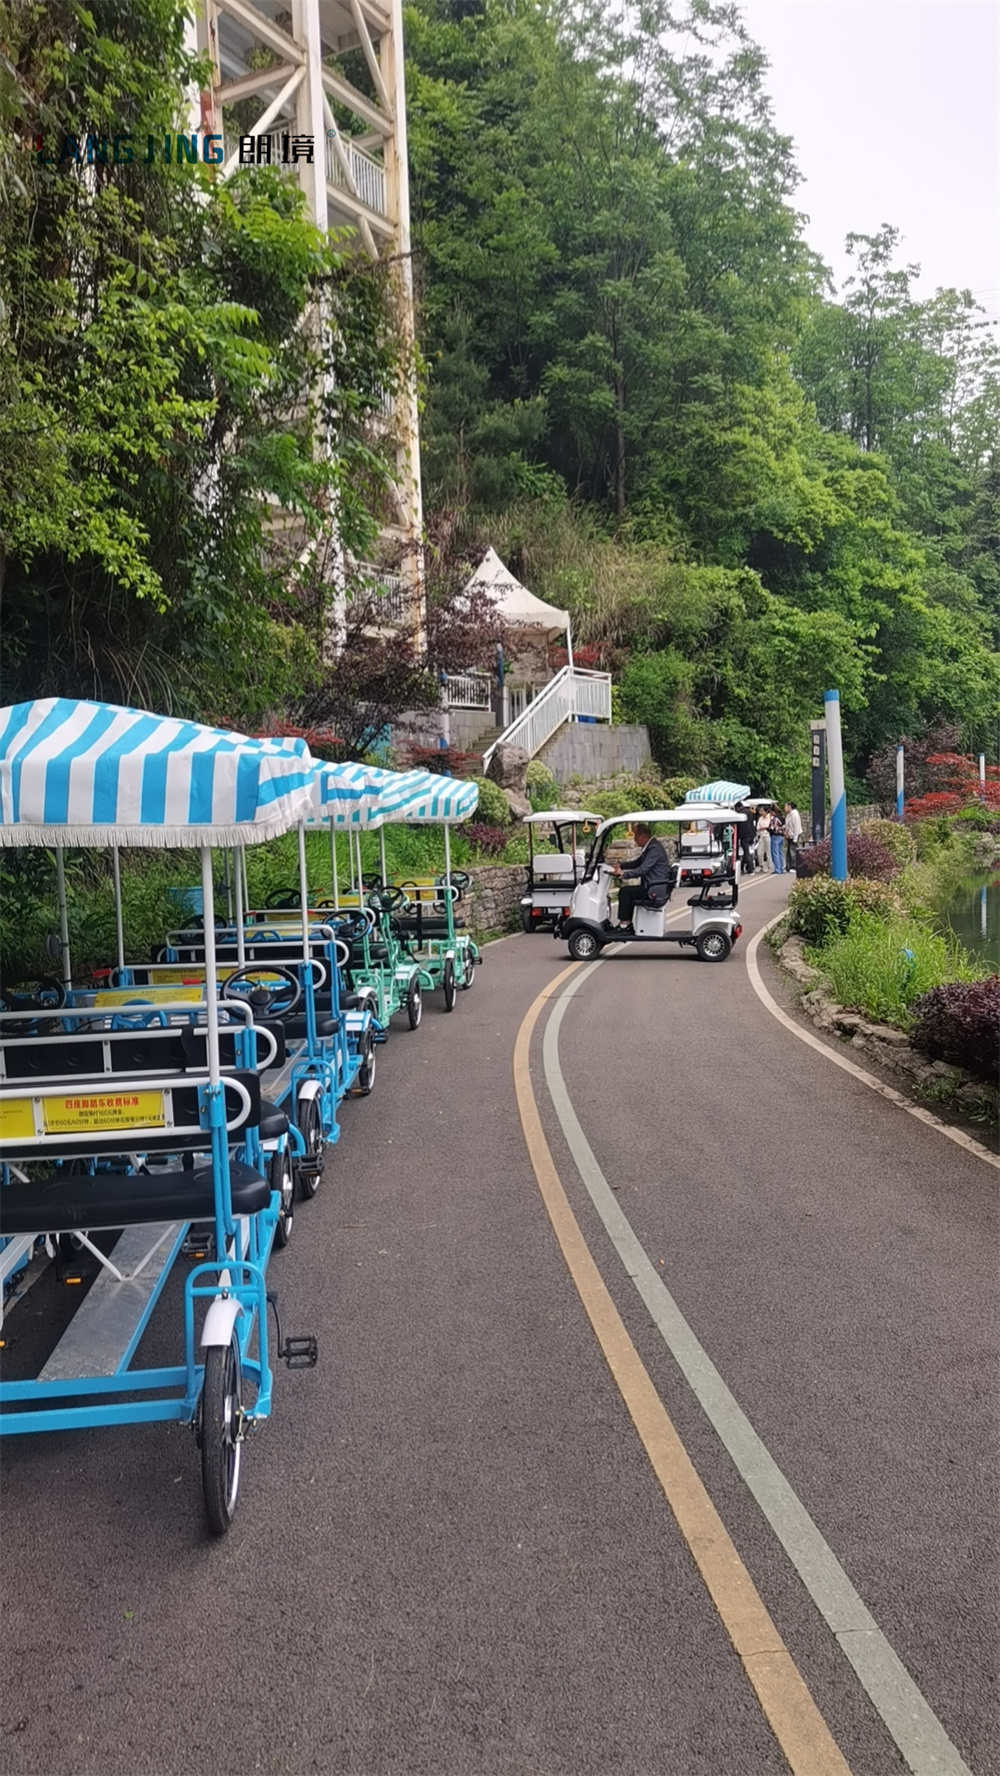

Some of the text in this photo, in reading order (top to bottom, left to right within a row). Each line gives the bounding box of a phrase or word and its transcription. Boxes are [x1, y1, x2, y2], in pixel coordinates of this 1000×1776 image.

[64, 1096, 140, 1109] 四座脚踏车收费标准
